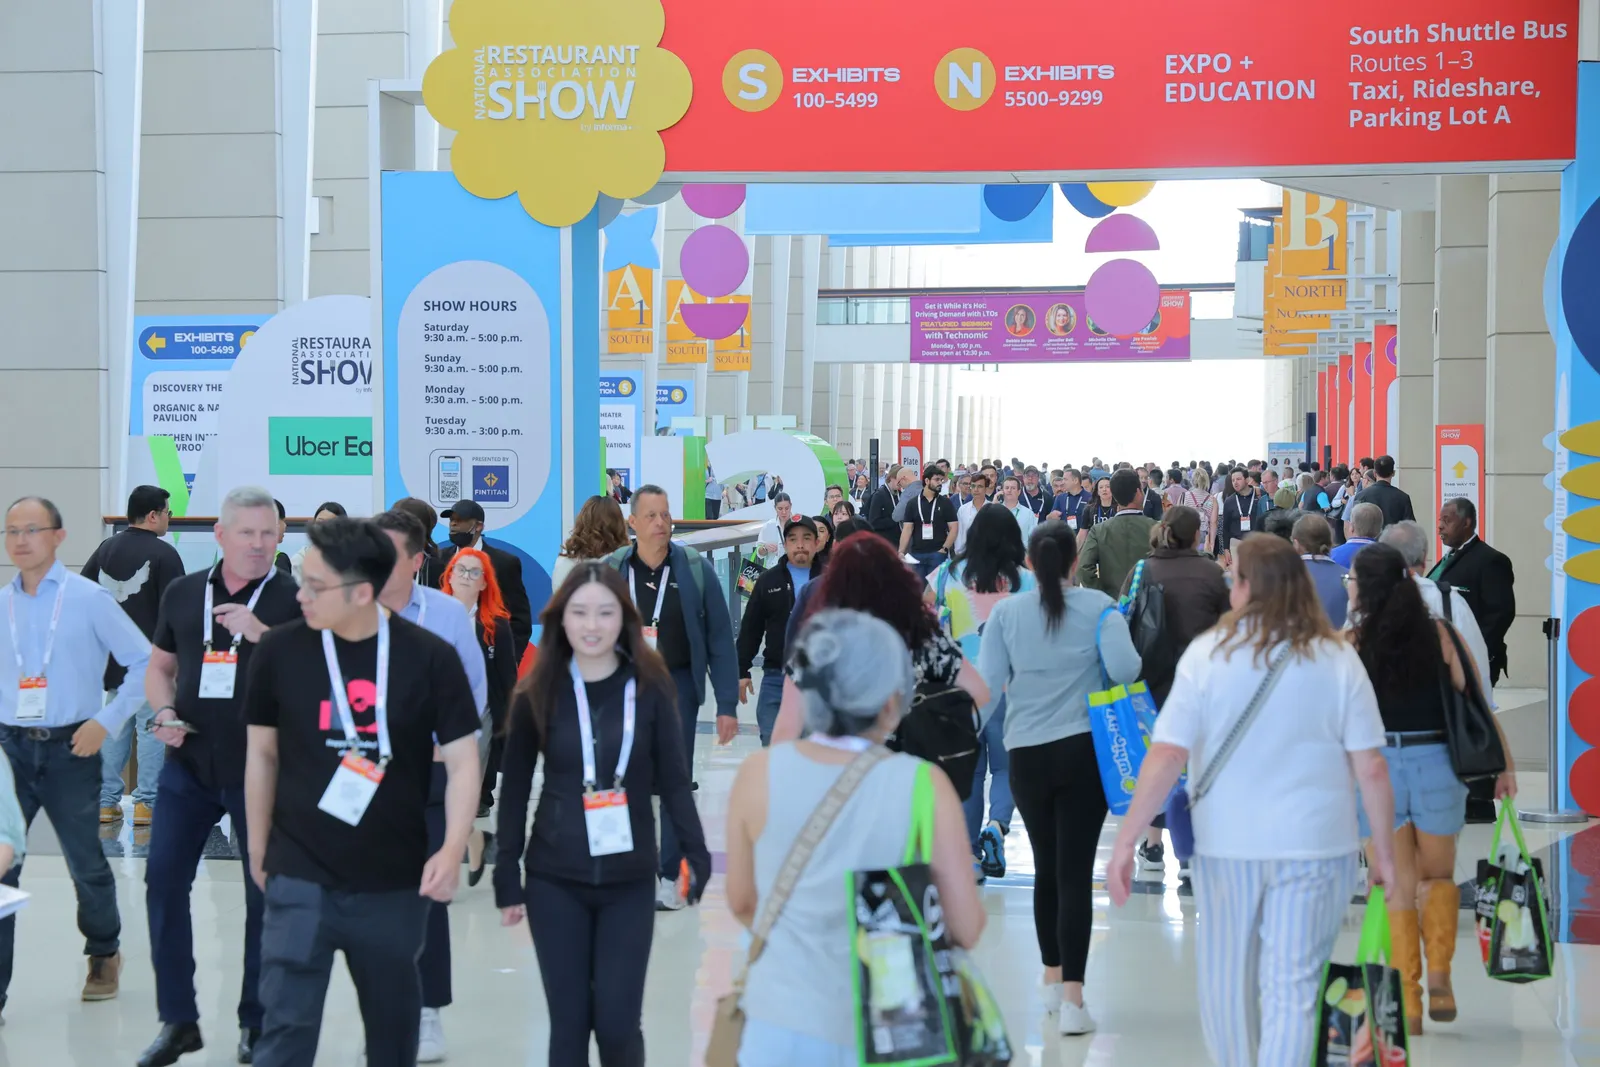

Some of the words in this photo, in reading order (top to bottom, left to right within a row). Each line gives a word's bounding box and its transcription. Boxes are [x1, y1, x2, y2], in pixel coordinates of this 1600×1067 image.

[1349, 24, 1419, 46] South
[1426, 21, 1515, 43] Shuttle
[1523, 20, 1568, 40] Bus
[487, 45, 640, 65] RESTAURANT
[1165, 53, 1231, 75] EXPO
[1240, 56, 1254, 70] +
[1349, 52, 1427, 73] Routes
[1435, 50, 1474, 71] 1–3
[488, 67, 637, 78] ASSOCIATION
[792, 67, 901, 83] EXHIBITS
[1005, 65, 1115, 82] EXHIBITS
[474, 46, 486, 120] NATIONAL
[738, 63, 768, 101] S
[948, 62, 982, 99] N
[1165, 79, 1316, 103] EDUCATION
[1349, 80, 1405, 105] Taxi,
[1413, 77, 1541, 99] Rideshare,
[487, 80, 636, 120] SHOW
[1349, 108, 1442, 131] Parking
[1449, 106, 1488, 126] Lot
[1493, 105, 1511, 125] A
[1282, 190, 1339, 250] B
[608, 265, 650, 310] A
[1284, 285, 1343, 298] NORTH
[424, 300, 466, 311] SHOW
[469, 300, 518, 311] HOURS
[424, 323, 469, 333] Saturday
[173, 332, 235, 343] EXHIBITS
[424, 334, 445, 342] 9:30
[478, 334, 498, 342] 5:00
[500, 336, 523, 344] p.m.
[610, 335, 650, 345] SOUTH
[944, 331, 988, 339] Technomic
[300, 337, 372, 349] RESTAURA
[668, 346, 705, 355] SOUTH
[291, 337, 299, 385] NATIONAL
[424, 354, 461, 364] Sunday
[716, 355, 749, 364] SOUTH
[424, 365, 445, 373] 9:30
[478, 365, 498, 373] 5:00
[501, 366, 523, 375] p.m.
[152, 384, 203, 392] DISCOVERY
[205, 383, 224, 392] THE
[424, 385, 465, 395] Monday
[425, 396, 445, 404] 9:30
[479, 396, 499, 404] 5:00
[501, 397, 523, 406] p.m.
[153, 403, 196, 412] ORGANIC
[198, 404, 205, 412] &
[153, 413, 197, 422] PAVILION
[425, 416, 466, 426] Tuesday
[425, 427, 445, 435] 9:30
[479, 427, 499, 435] 3:00
[501, 428, 523, 437] p.m.
[286, 435, 339, 456] Uber
[345, 435, 373, 456] Ea
[903, 457, 919, 465] Plate
[474, 488, 507, 496] FINTITAN
